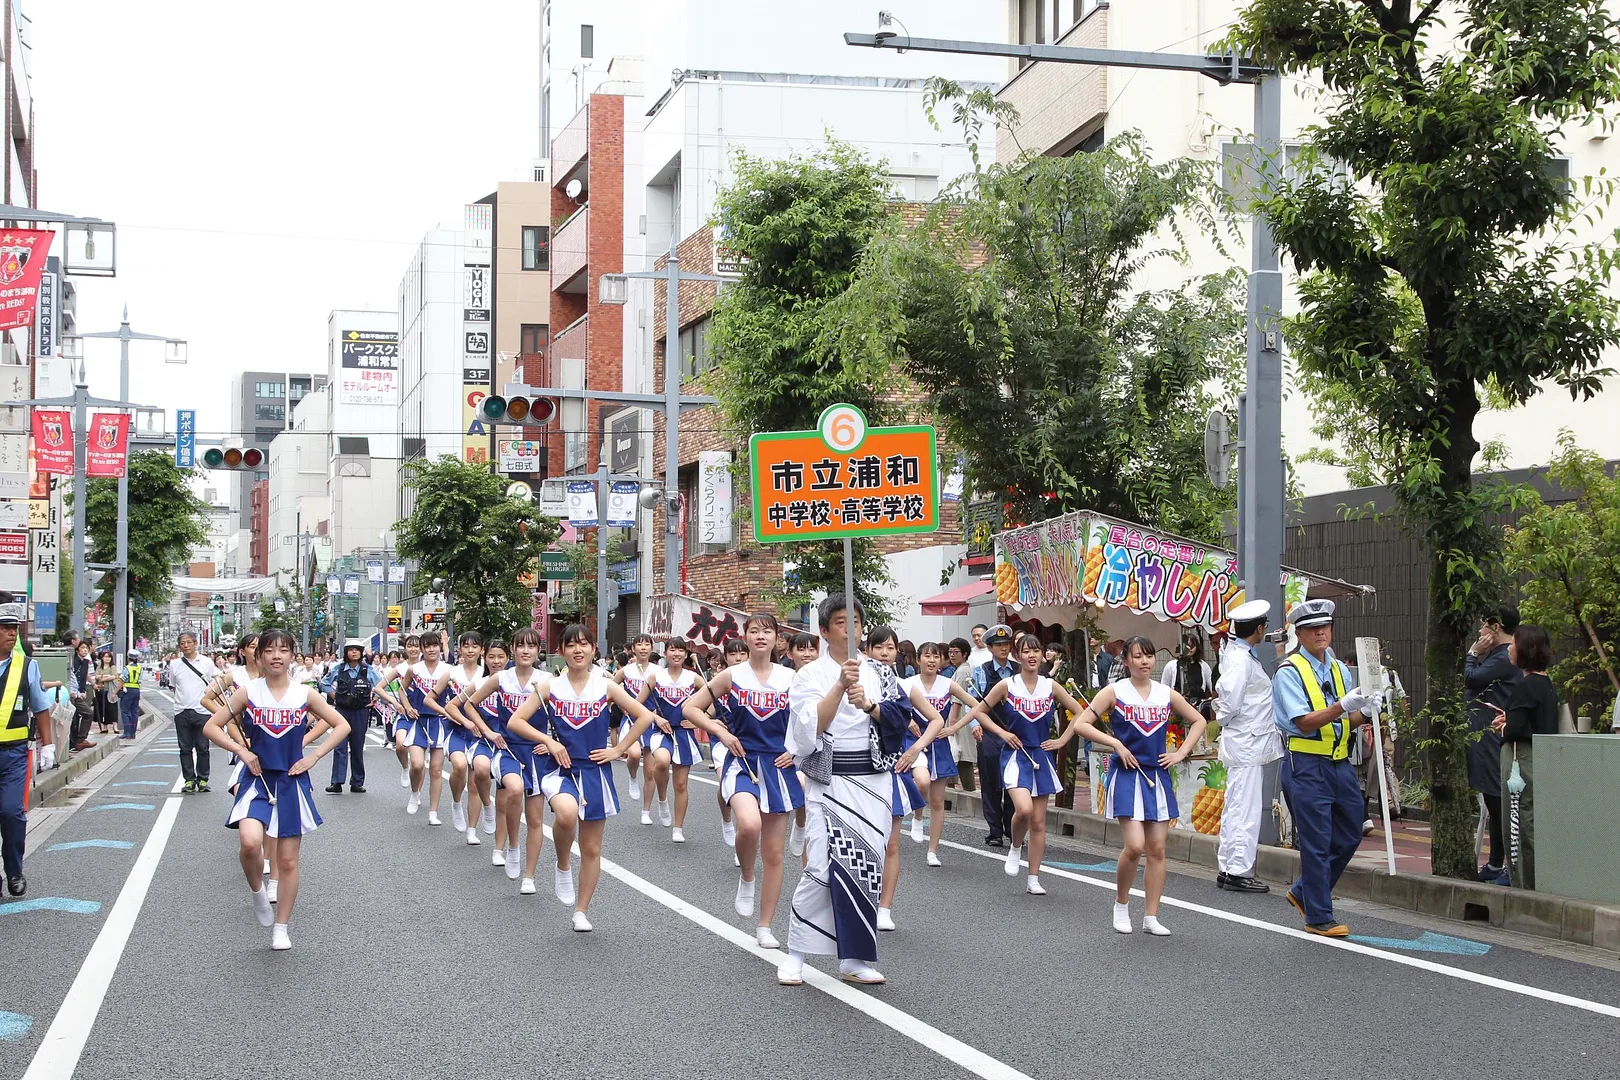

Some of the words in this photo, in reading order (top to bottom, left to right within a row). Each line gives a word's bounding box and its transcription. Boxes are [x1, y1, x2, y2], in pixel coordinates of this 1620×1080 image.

[472, 270, 482, 307] YOGA
[469, 370, 487, 379] 3F
[180, 411, 192, 466] 押ボタン信号
[830, 413, 856, 447] 6
[506, 461, 533, 471] 七田式
[770, 455, 920, 493] 市立浦和
[767, 495, 925, 529] 中学校・高等学校
[659, 687, 690, 697] MUHS
[738, 690, 787, 710] MUHS
[554, 700, 601, 718] MUHS
[1014, 698, 1050, 712] MUHS
[1125, 706, 1168, 721] MUHS
[253, 708, 302, 726] MUHS
